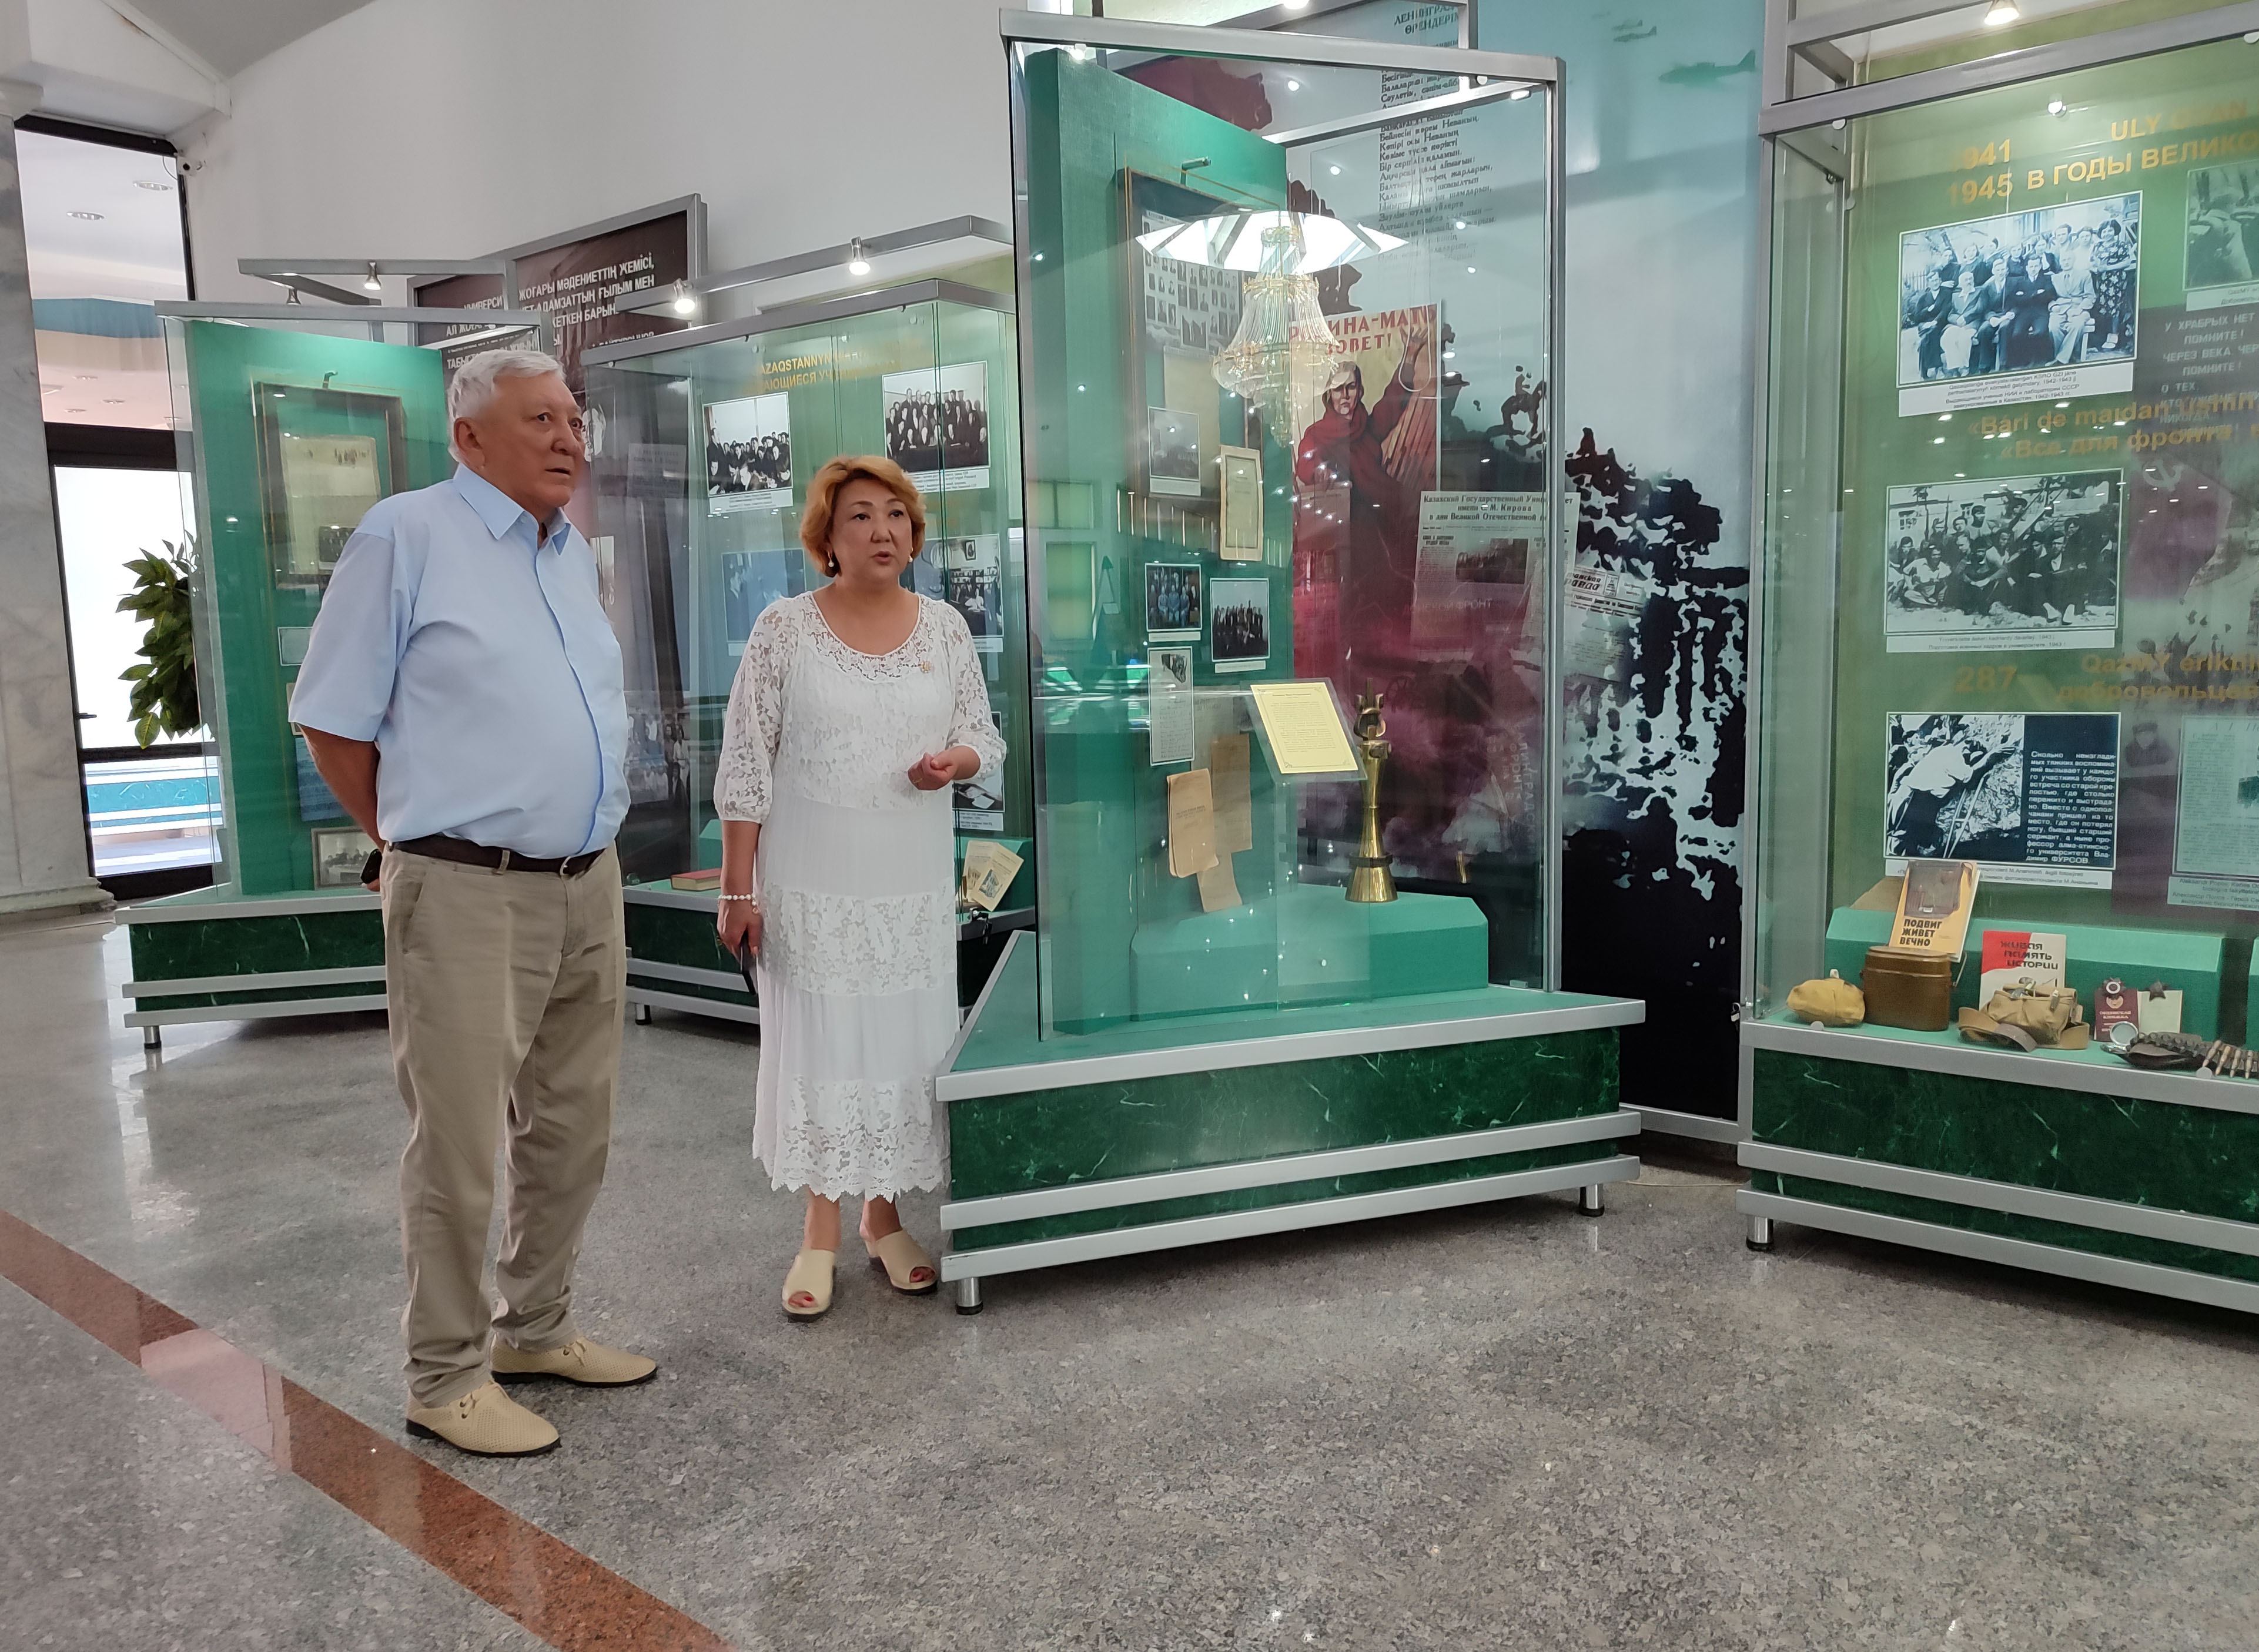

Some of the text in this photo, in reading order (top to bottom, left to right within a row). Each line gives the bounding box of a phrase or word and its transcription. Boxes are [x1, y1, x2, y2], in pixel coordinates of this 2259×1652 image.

[2027, 170, 2044, 190] В
[2053, 156, 2131, 185] ГОДЫ
[557, 267, 617, 291] МӘДЕНИЕТТІҢ
[635, 274, 655, 290] МЕН
[2178, 316, 2228, 330] ХРАБРЫХ
[2234, 313, 2255, 324] НЕТ
[2184, 330, 2237, 344] ПОМНИТЕ
[2163, 350, 2197, 362] ЧЕРЕЗ
[2183, 362, 2234, 376] ПОМНИТЕ
[1953, 665, 2017, 693] 287
[1904, 919, 1942, 929] ПОДВИГ
[1902, 927, 1936, 938] ЖИВЕТ
[1899, 936, 1930, 947] ВЕЧНО
[2004, 950, 2052, 960] ПАМЯТЬ
[2007, 959, 2058, 970] ИСТОРИИ
